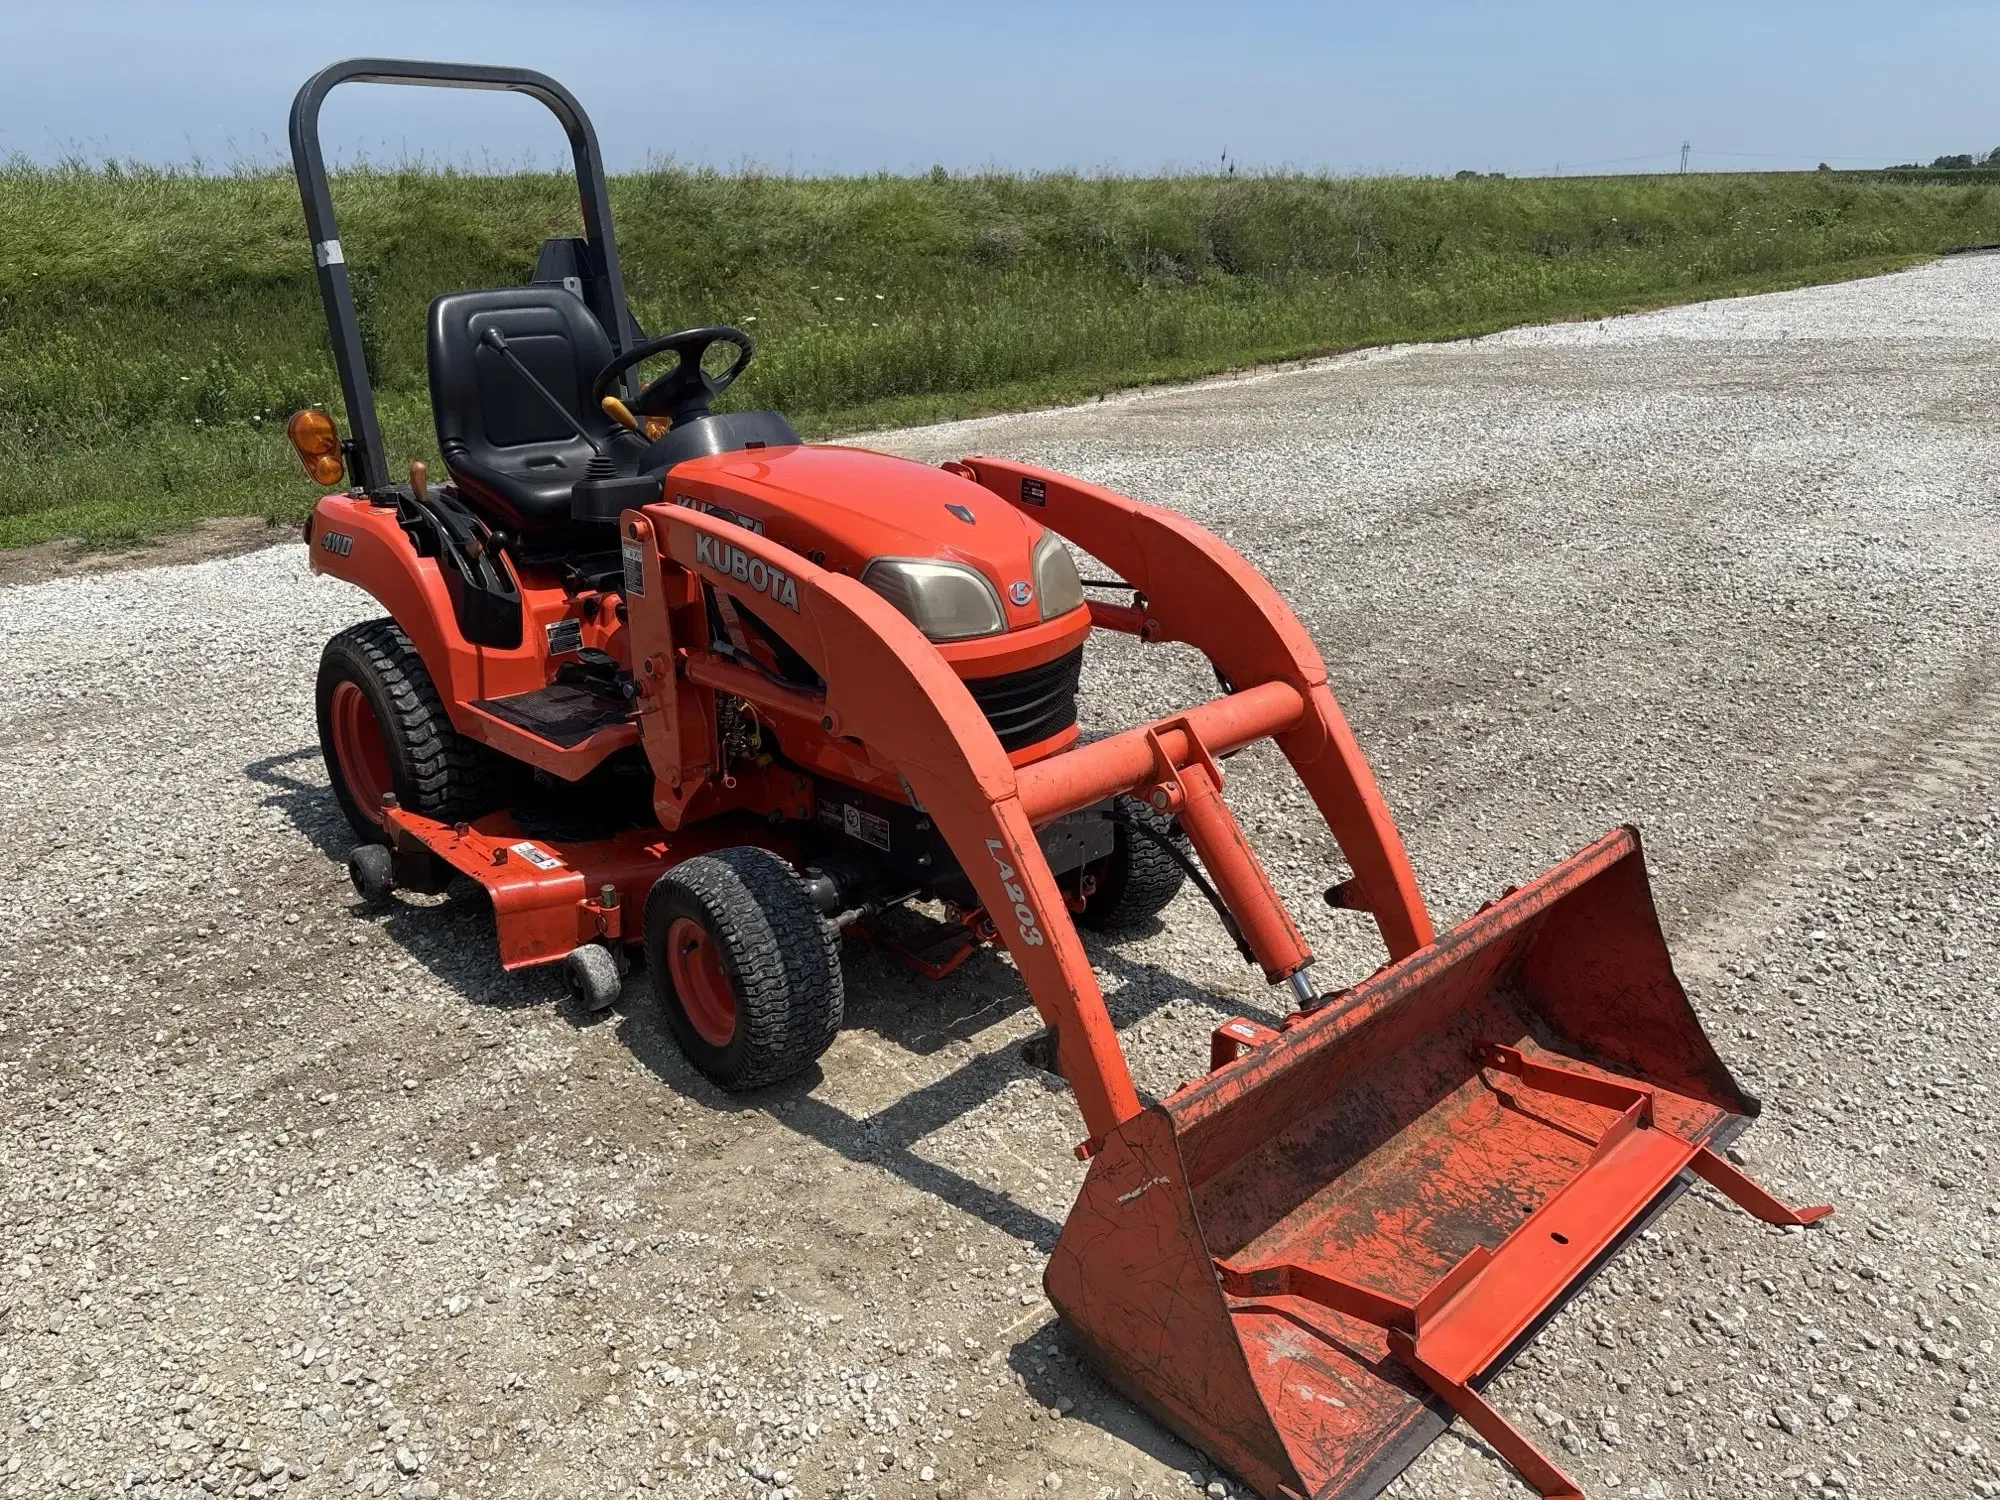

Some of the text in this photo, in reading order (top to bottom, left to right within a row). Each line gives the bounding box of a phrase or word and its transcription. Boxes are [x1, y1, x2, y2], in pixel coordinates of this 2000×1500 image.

[321, 531, 353, 556] 4WD
[695, 531, 800, 614] KUBOTA
[984, 839, 1044, 945] LA203
